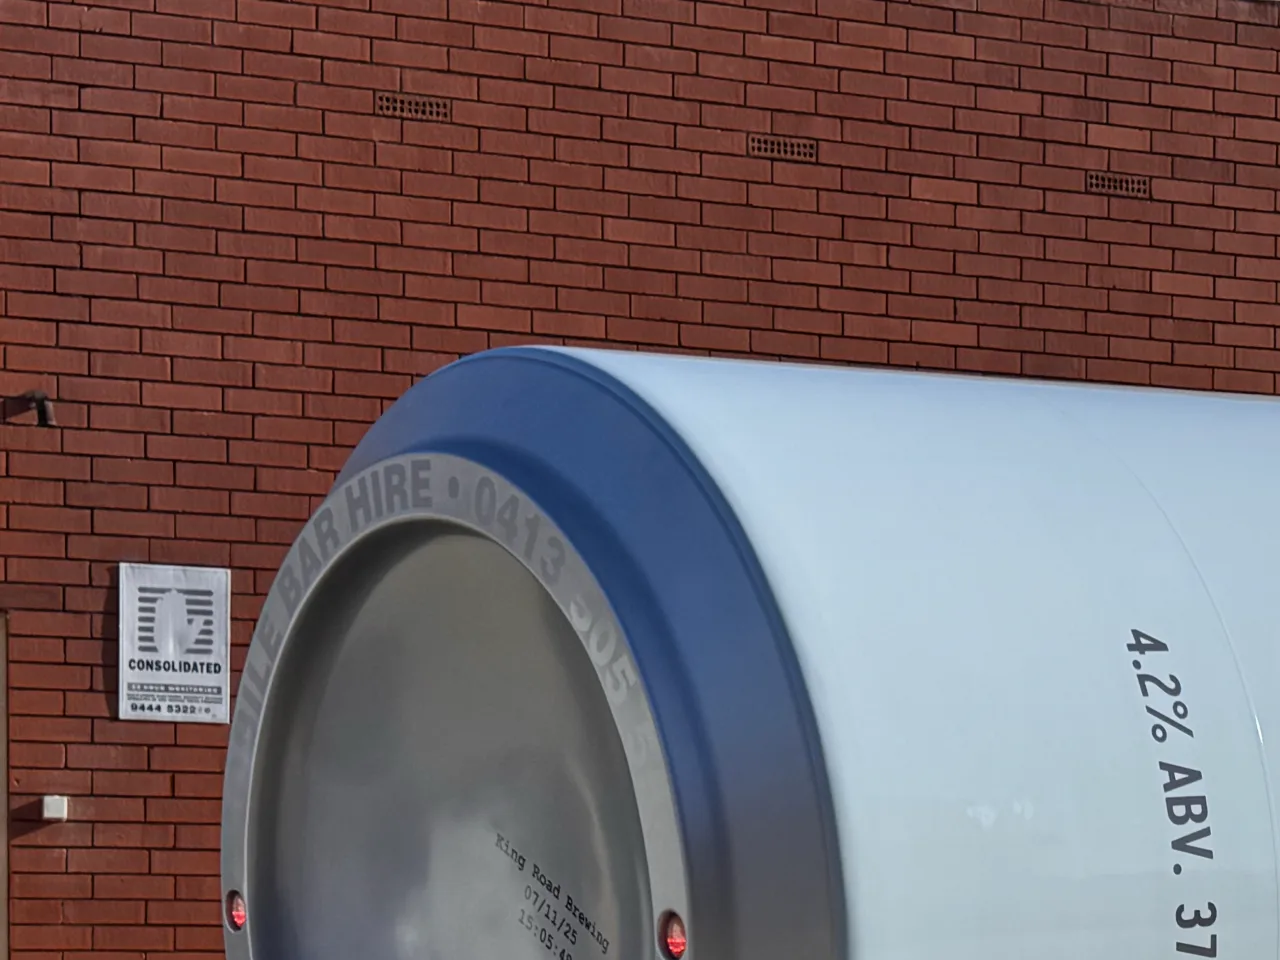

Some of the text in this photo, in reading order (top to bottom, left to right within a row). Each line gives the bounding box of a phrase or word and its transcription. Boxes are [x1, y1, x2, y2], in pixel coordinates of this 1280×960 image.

[277, 518, 341, 616] BAR
[344, 459, 433, 531] HIRE
[475, 476, 566, 586] 0413
[128, 658, 222, 674] CONSOLIDATED
[1126, 628, 1194, 743] 4.2%
[1158, 760, 1214, 876] ABV.
[494, 832, 610, 955] King Road Brewing
[524, 885, 578, 946] 07/11/25
